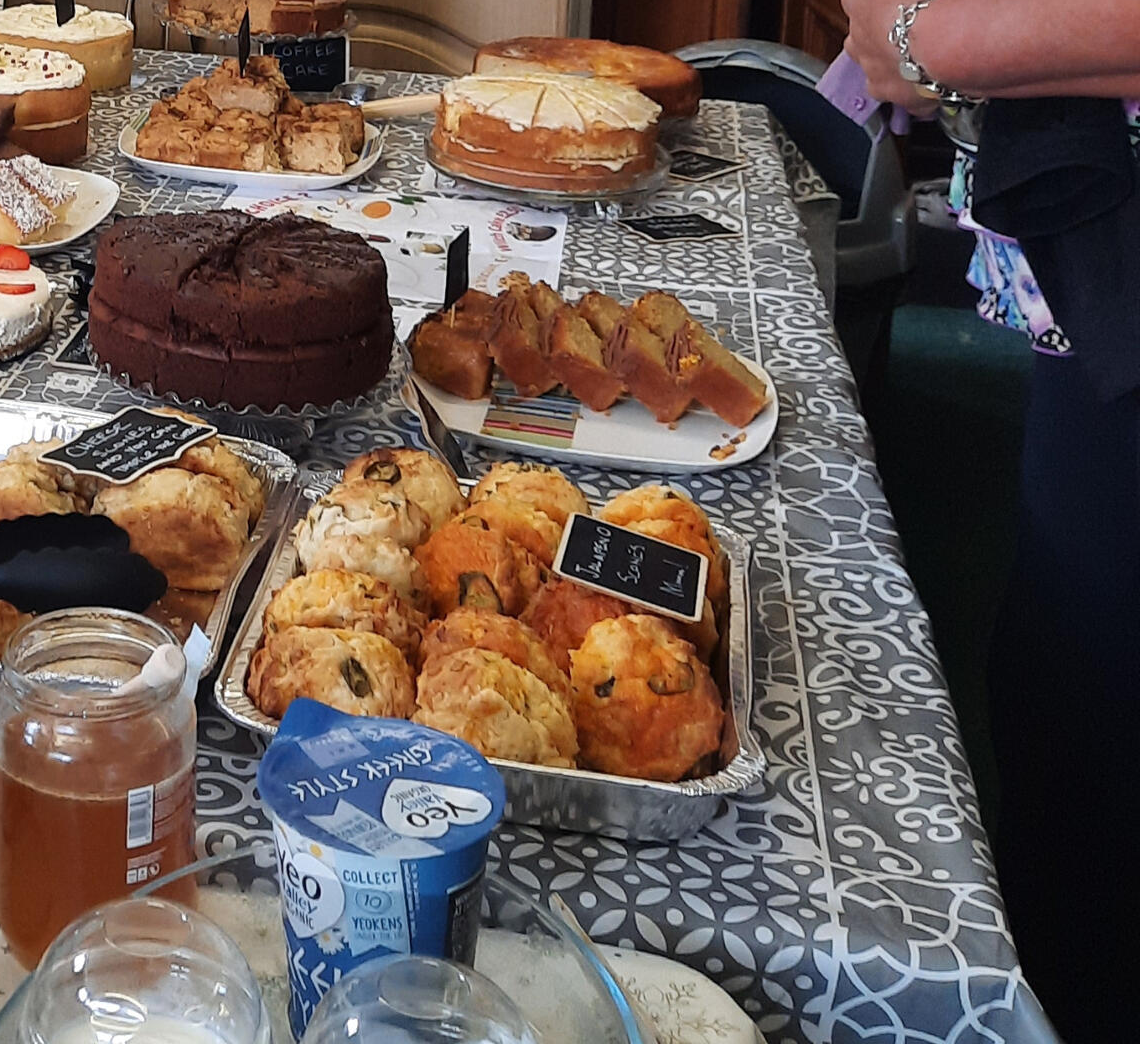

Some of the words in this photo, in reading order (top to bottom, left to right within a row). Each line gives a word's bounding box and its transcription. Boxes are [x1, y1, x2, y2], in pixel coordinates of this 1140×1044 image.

[273, 43, 335, 58] COFFEE
[281, 62, 329, 79] CAKE
[64, 420, 133, 458] CHEESE
[124, 439, 148, 454] YOU
[356, 744, 433, 781] GREEK
[287, 768, 359, 802] STYLE
[342, 869, 398, 885] COLLECT
[364, 894, 382, 909] 10
[351, 915, 403, 931] YEOKENS
